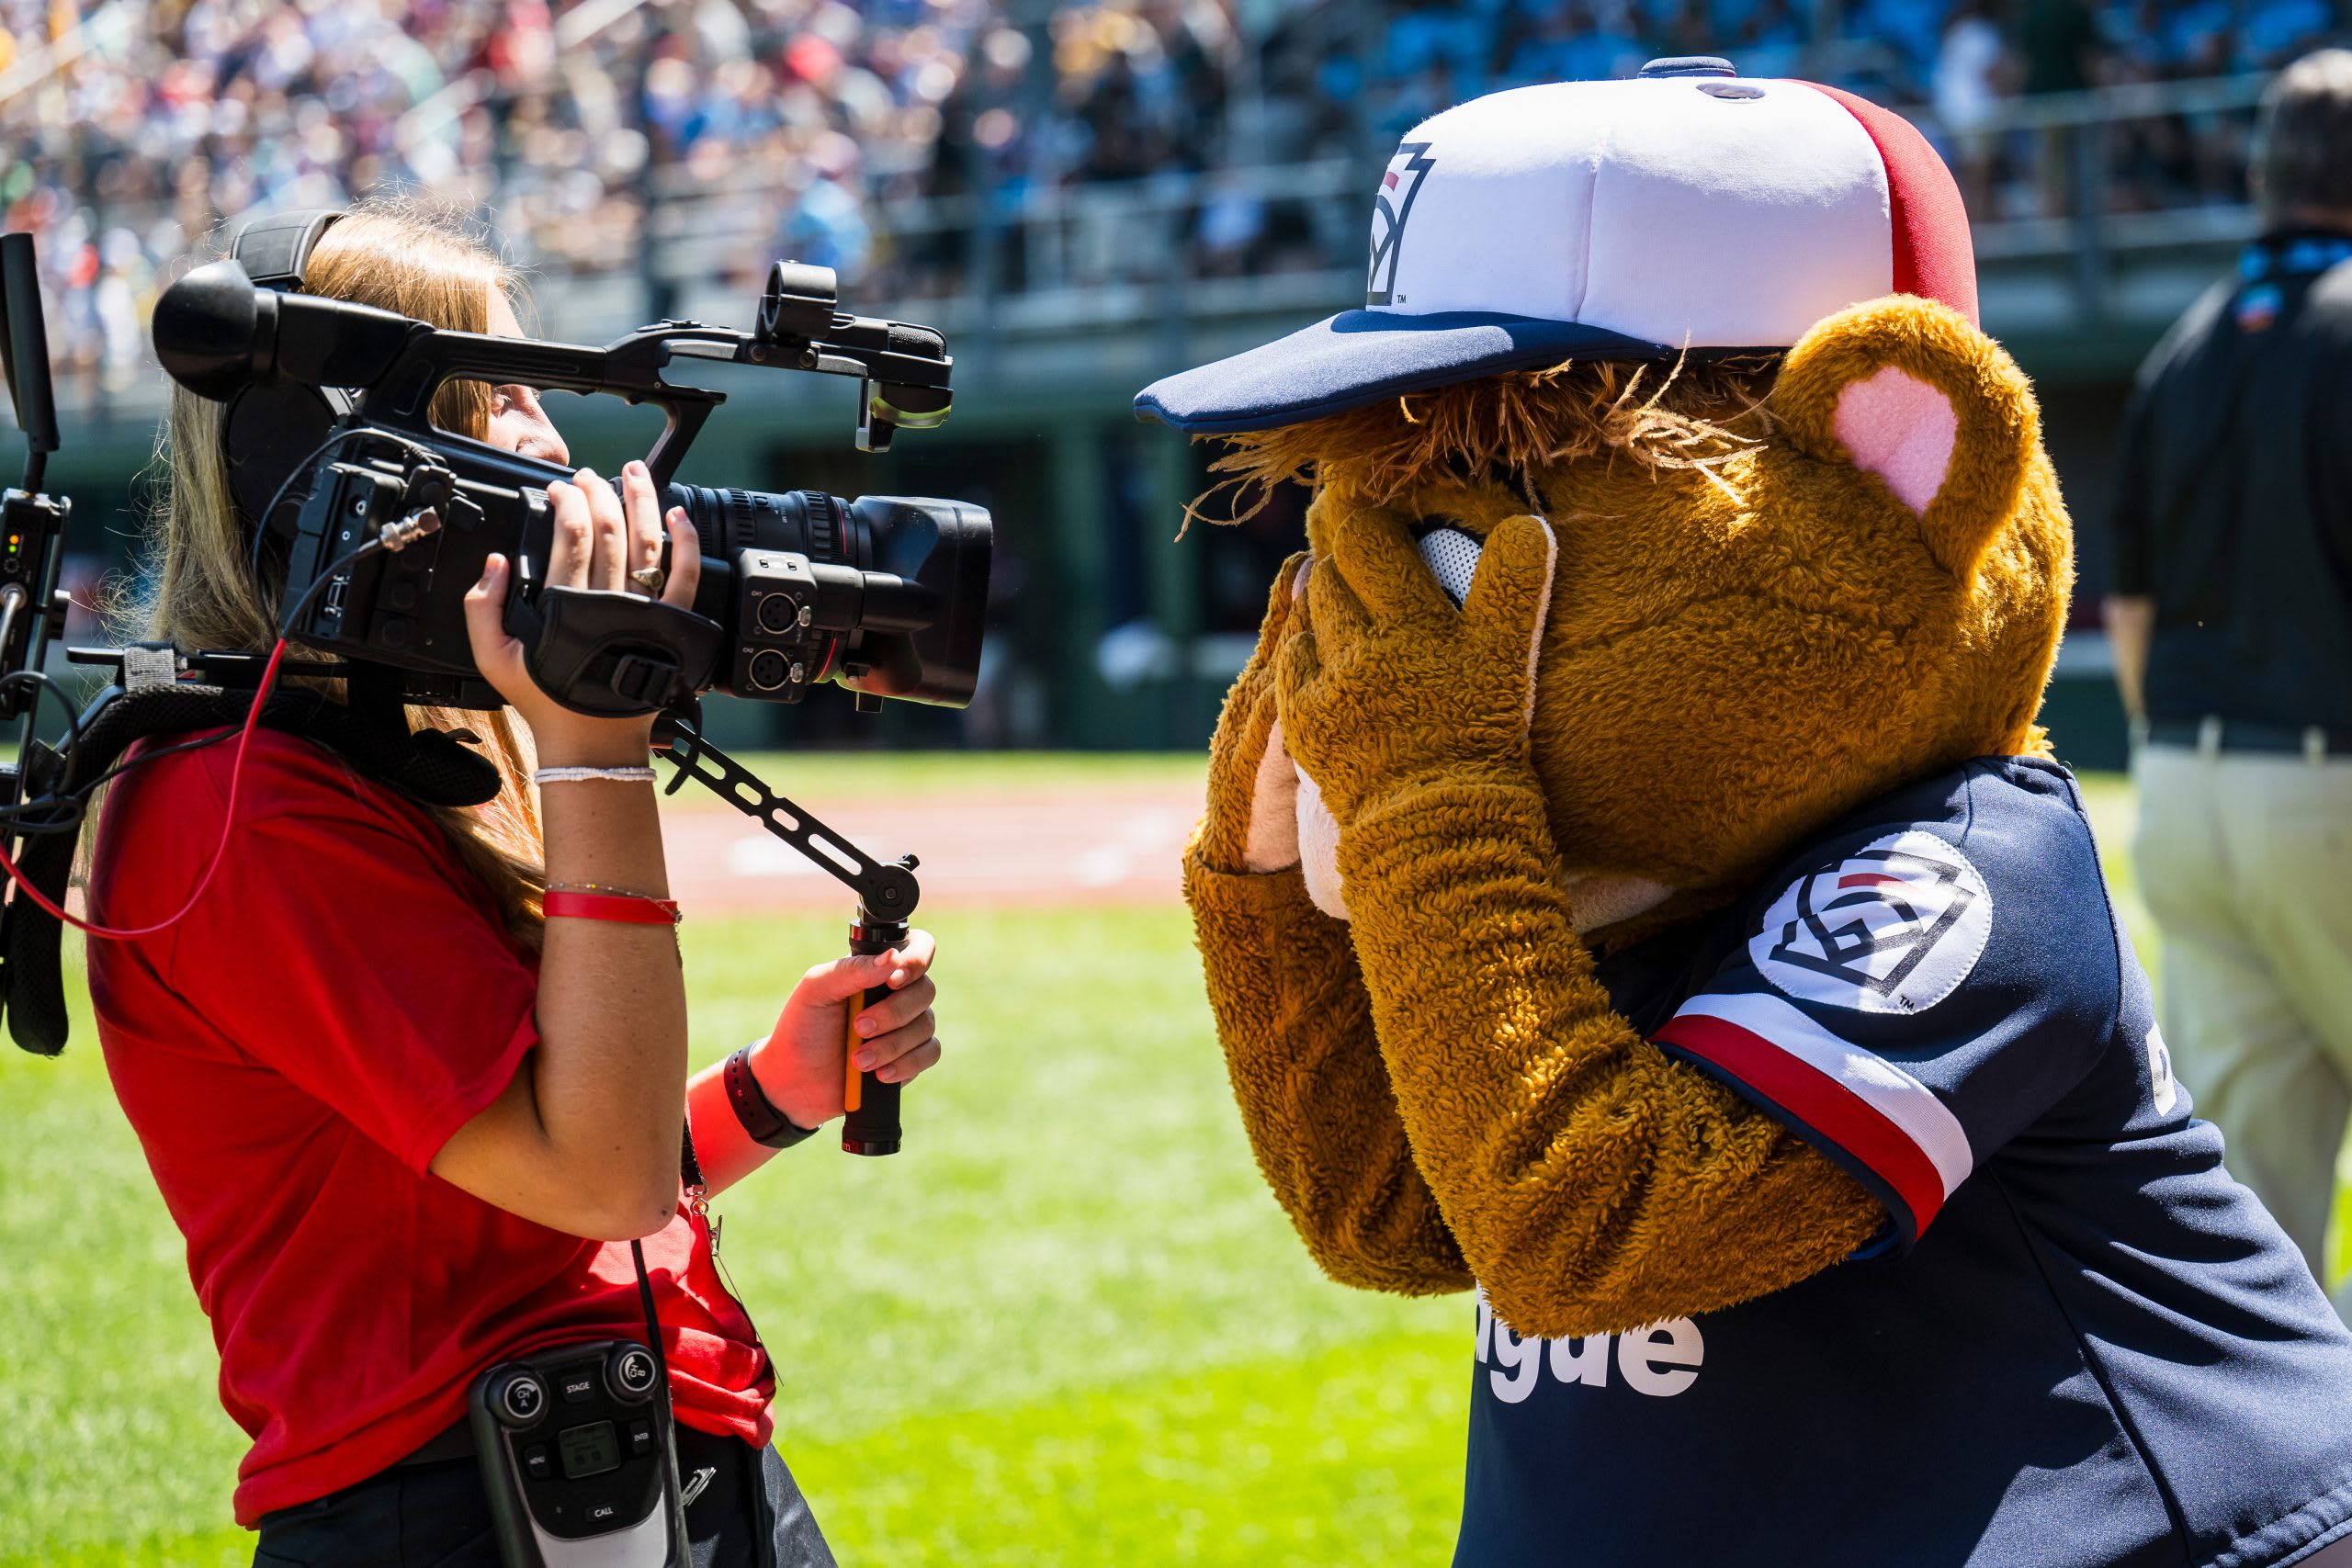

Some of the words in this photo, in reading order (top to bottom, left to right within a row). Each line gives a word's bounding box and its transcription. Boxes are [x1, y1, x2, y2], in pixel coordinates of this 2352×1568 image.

[1396, 294, 1407, 304] TM
[1899, 995, 1916, 1010] TM
[566, 1381, 591, 1393] STAGE
[516, 1390, 530, 1399] CH
[520, 1399, 528, 1407] A
[594, 1506, 614, 1517] CALL
